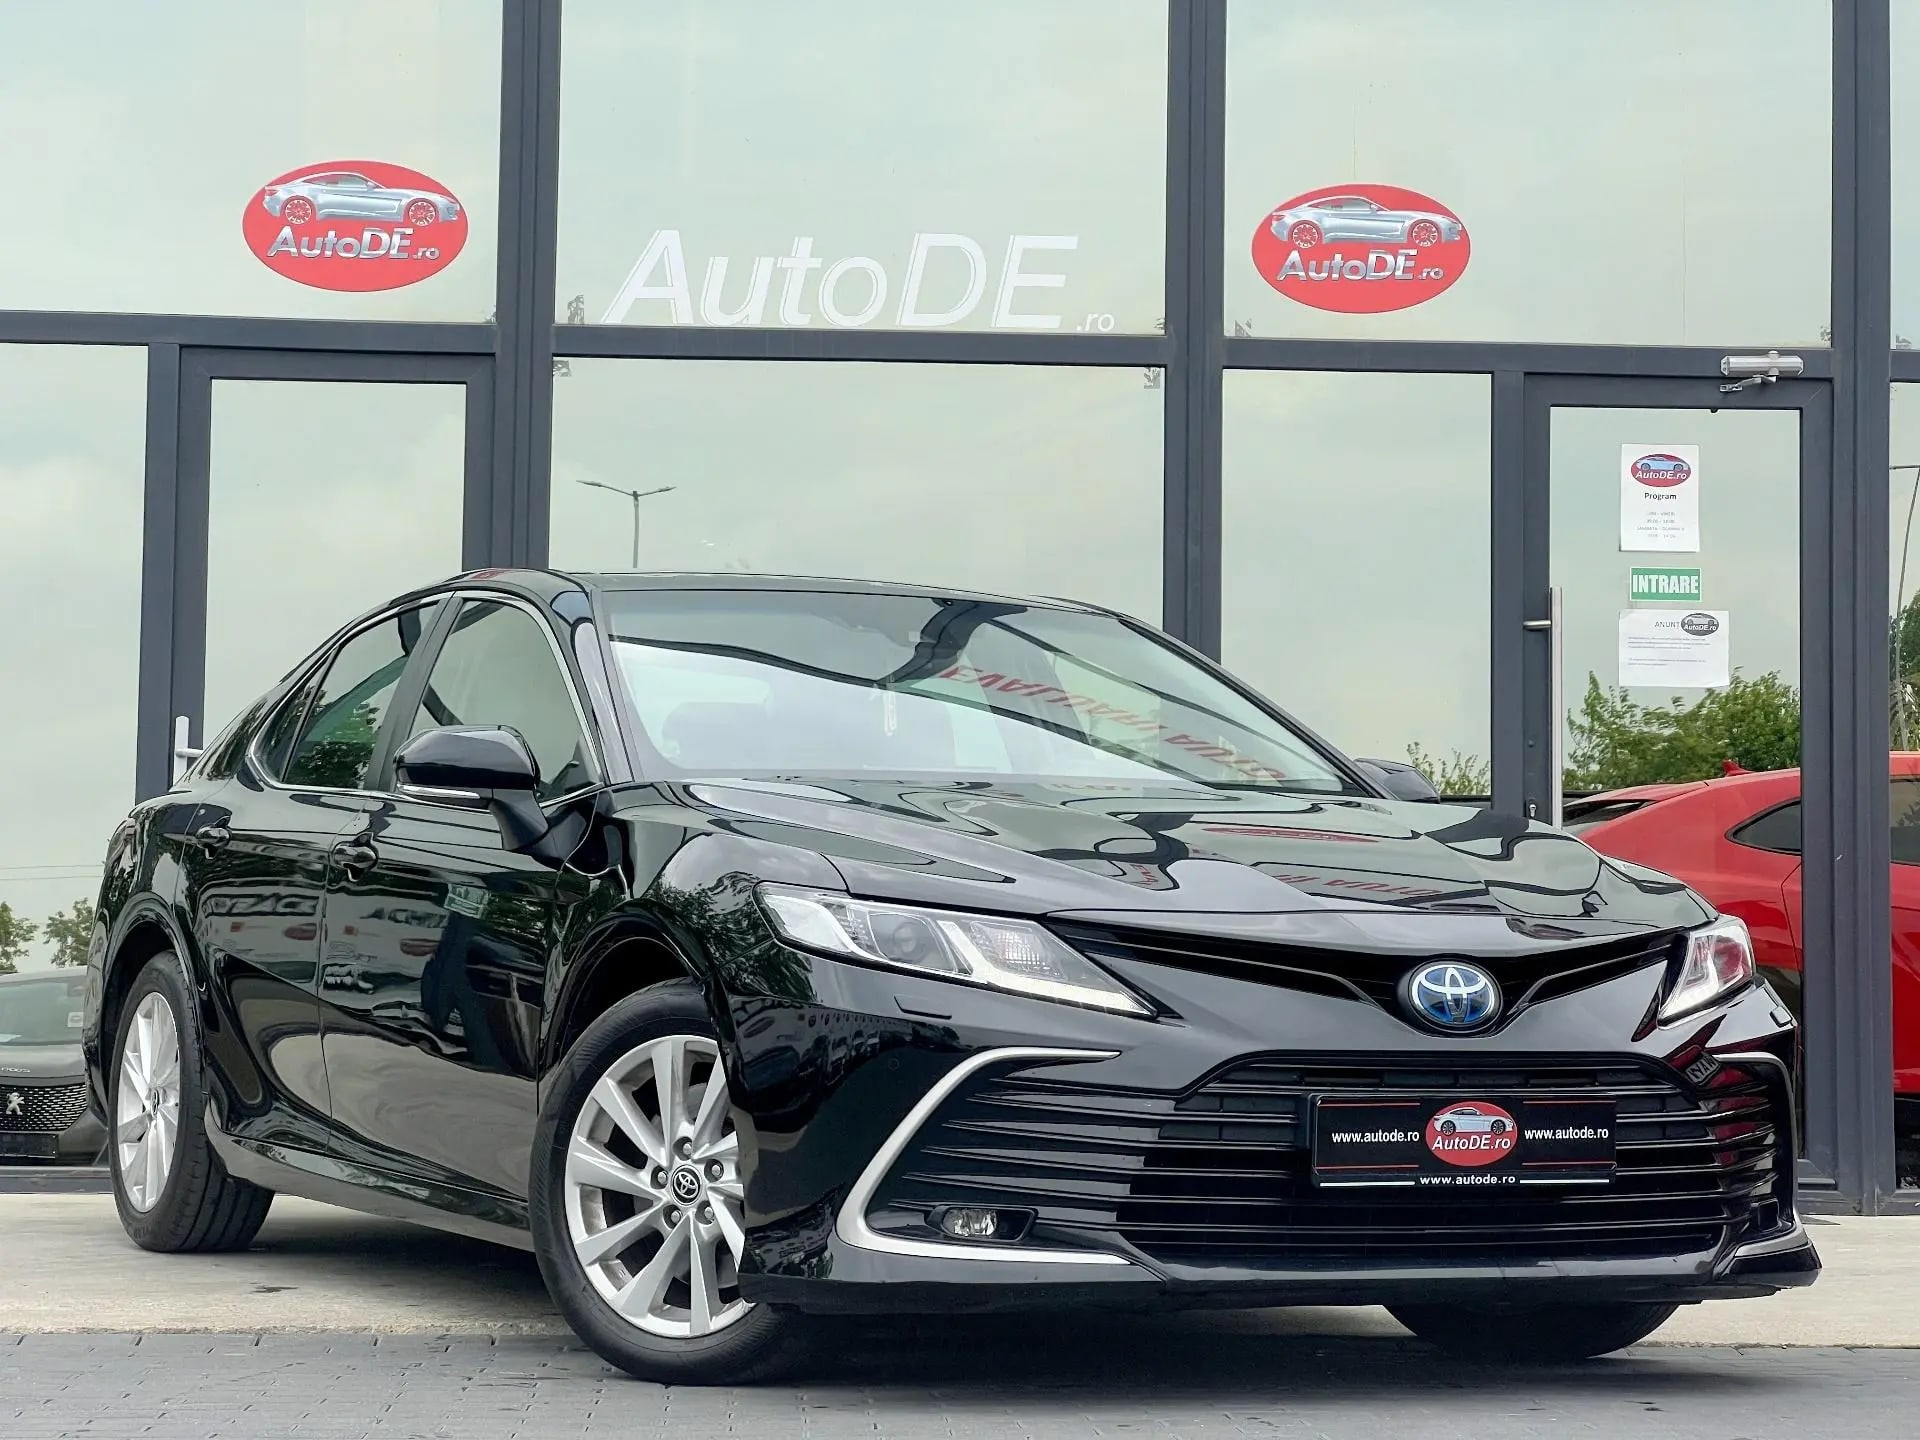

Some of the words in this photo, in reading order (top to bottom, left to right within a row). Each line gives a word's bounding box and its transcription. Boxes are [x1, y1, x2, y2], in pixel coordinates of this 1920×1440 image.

[1635, 470, 1687, 480] AutoDE.ro
[1644, 492, 1677, 501] Program
[1632, 574, 1699, 593] INTRARE
[1331, 1128, 1420, 1143] www.autode.ro
[1431, 1134, 1511, 1151] AutoDE.ro
[1524, 1125, 1609, 1140] www.autode.ro
[1420, 1174, 1516, 1185] www.autode.ro
